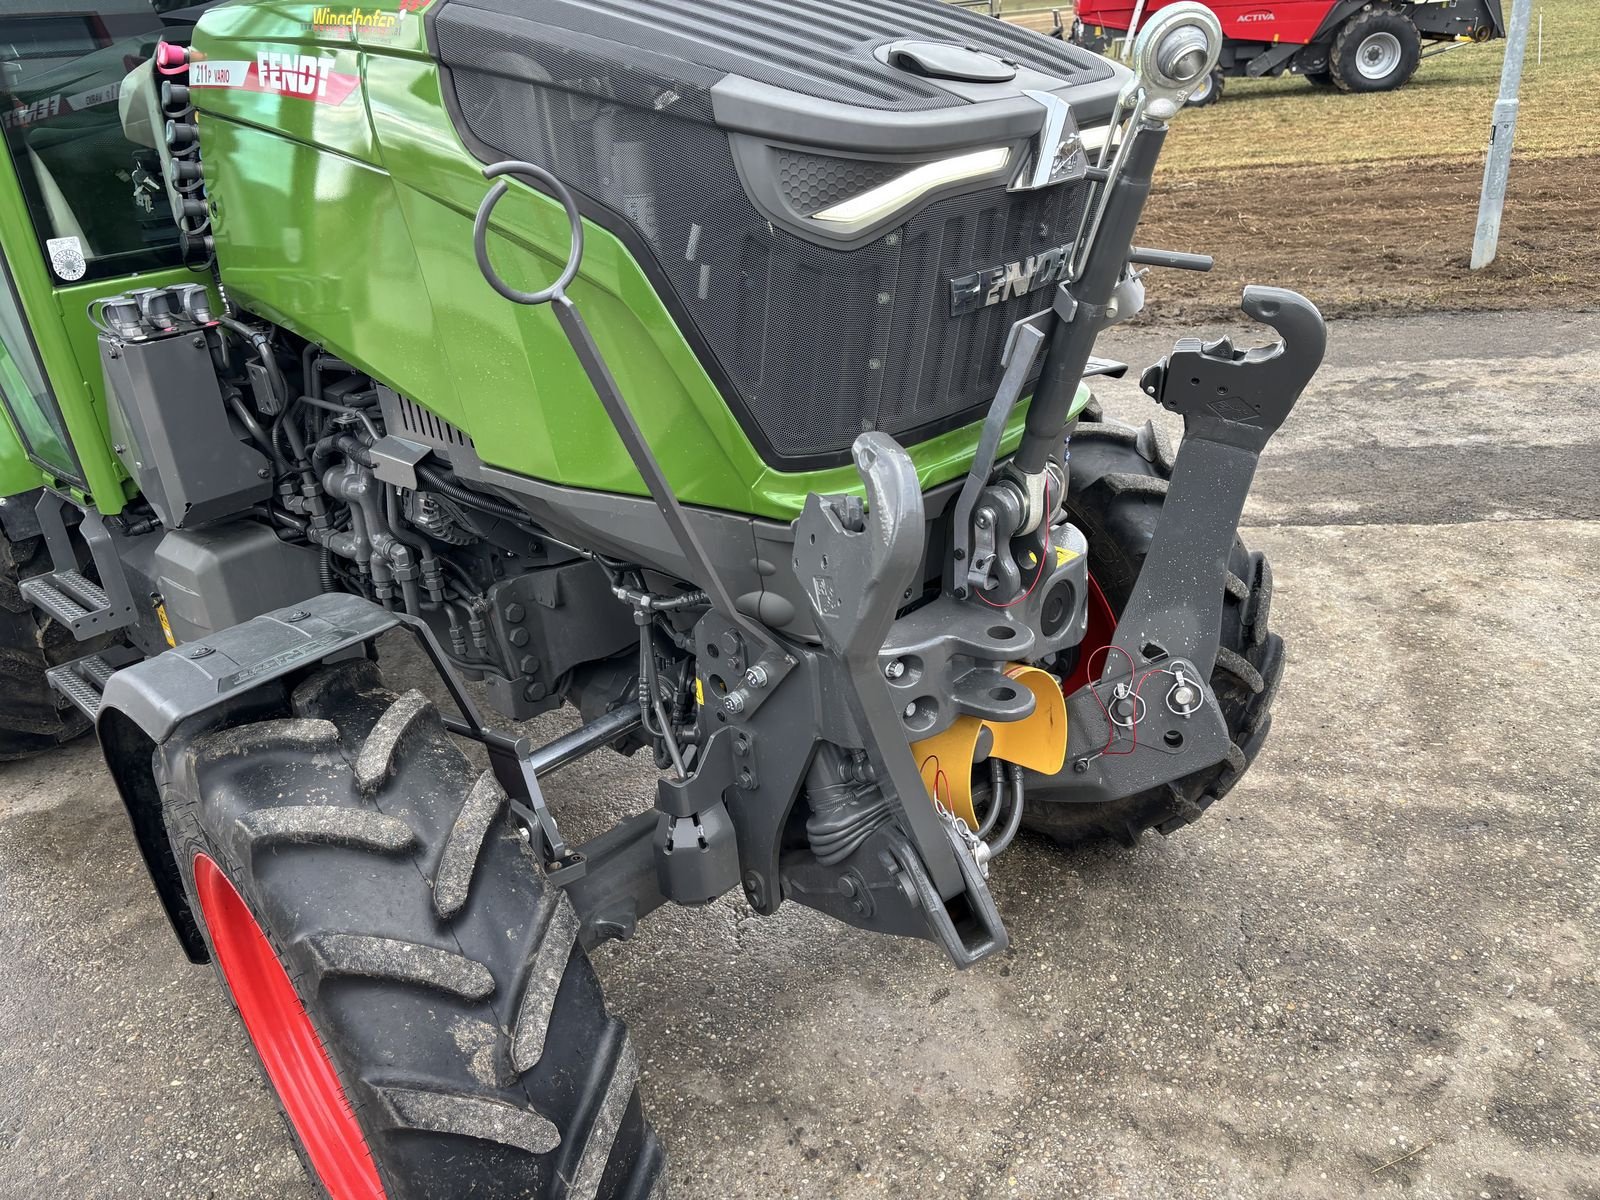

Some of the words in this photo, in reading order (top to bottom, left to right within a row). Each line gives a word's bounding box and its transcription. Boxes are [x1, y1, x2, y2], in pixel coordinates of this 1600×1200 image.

[1237, 13, 1275, 22] ACTIVA
[214, 69, 230, 83] VARIO
[257, 51, 336, 97] FENDT
